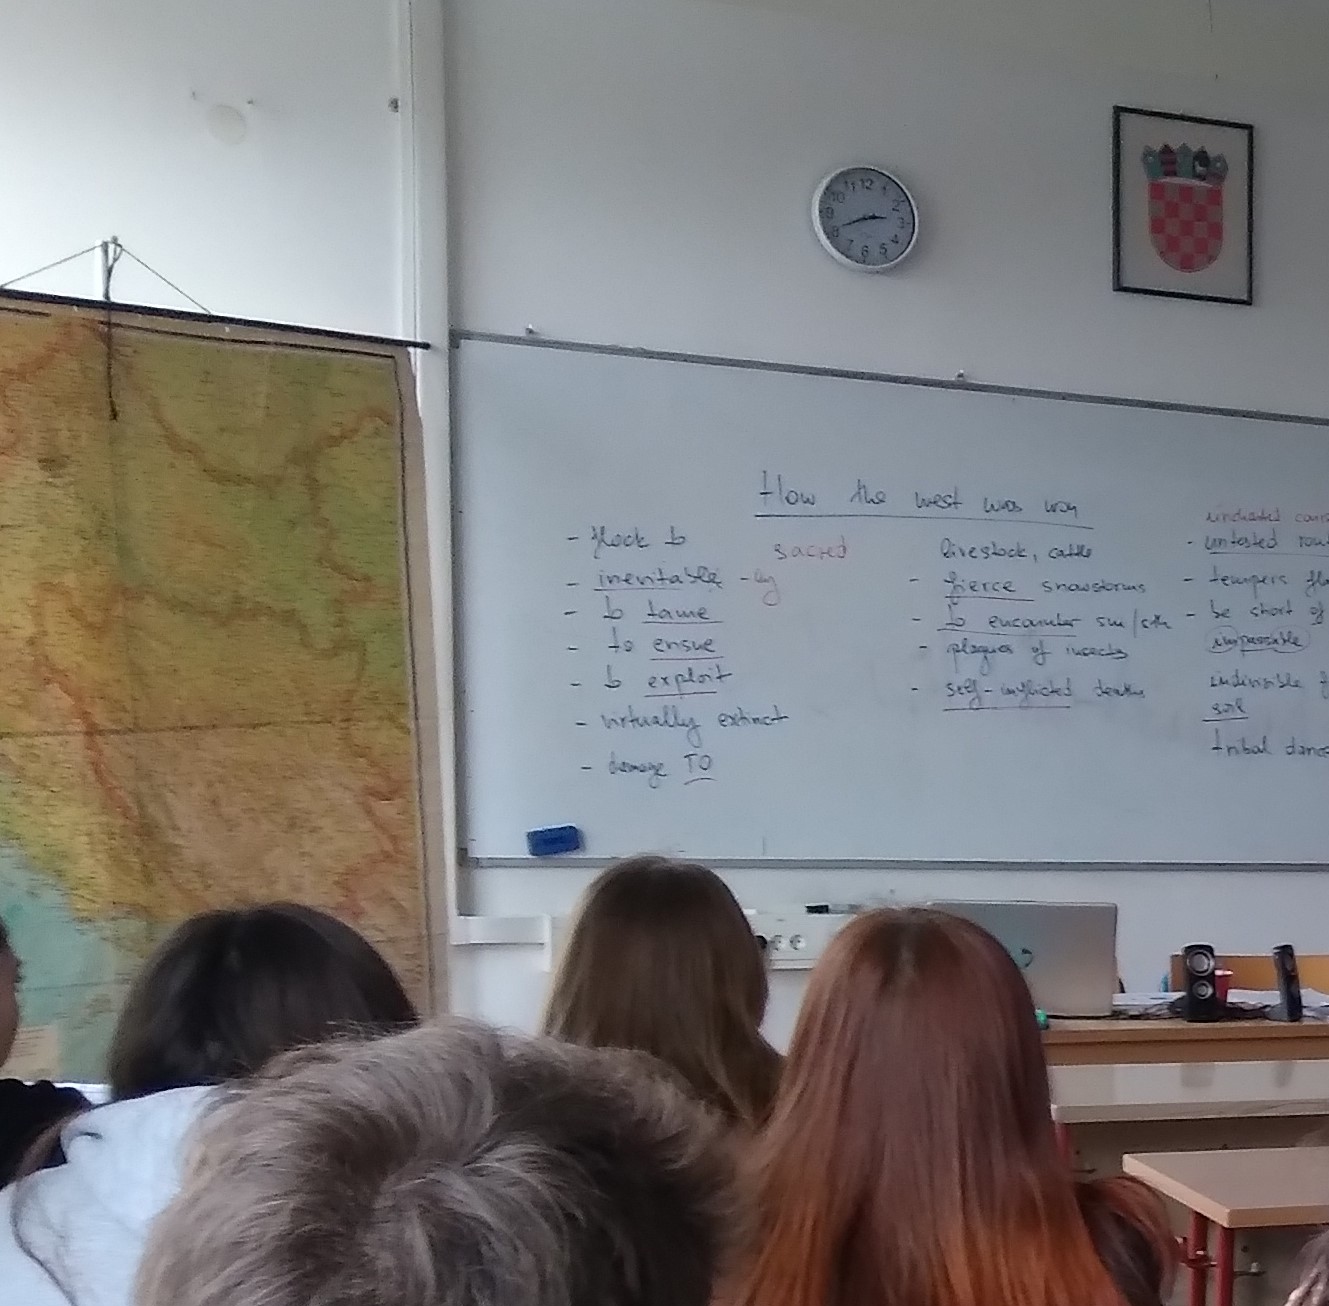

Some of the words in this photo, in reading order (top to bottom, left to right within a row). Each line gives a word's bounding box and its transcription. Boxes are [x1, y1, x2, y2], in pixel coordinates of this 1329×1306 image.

[860, 178, 874, 191] 12
[760, 470, 816, 507] How
[850, 478, 887, 505] the
[914, 485, 964, 511] west
[983, 496, 1023, 514] was
[590, 525, 651, 560] flock
[773, 534, 848, 560] sacred
[1048, 543, 1093, 560] cattle
[599, 566, 724, 588] inevitable
[943, 571, 1017, 605] fierce
[1041, 578, 1147, 594] snowstorms
[1209, 564, 1288, 600] tempers
[646, 599, 711, 621] tame
[1210, 599, 1231, 619] be
[1250, 599, 1294, 618] short
[1309, 600, 1325, 626] of
[608, 626, 634, 652] to
[653, 636, 716, 653] ensue
[1031, 639, 1052, 666] of
[648, 663, 734, 699] exploit
[600, 704, 703, 749] virtually
[683, 752, 714, 774] TO
